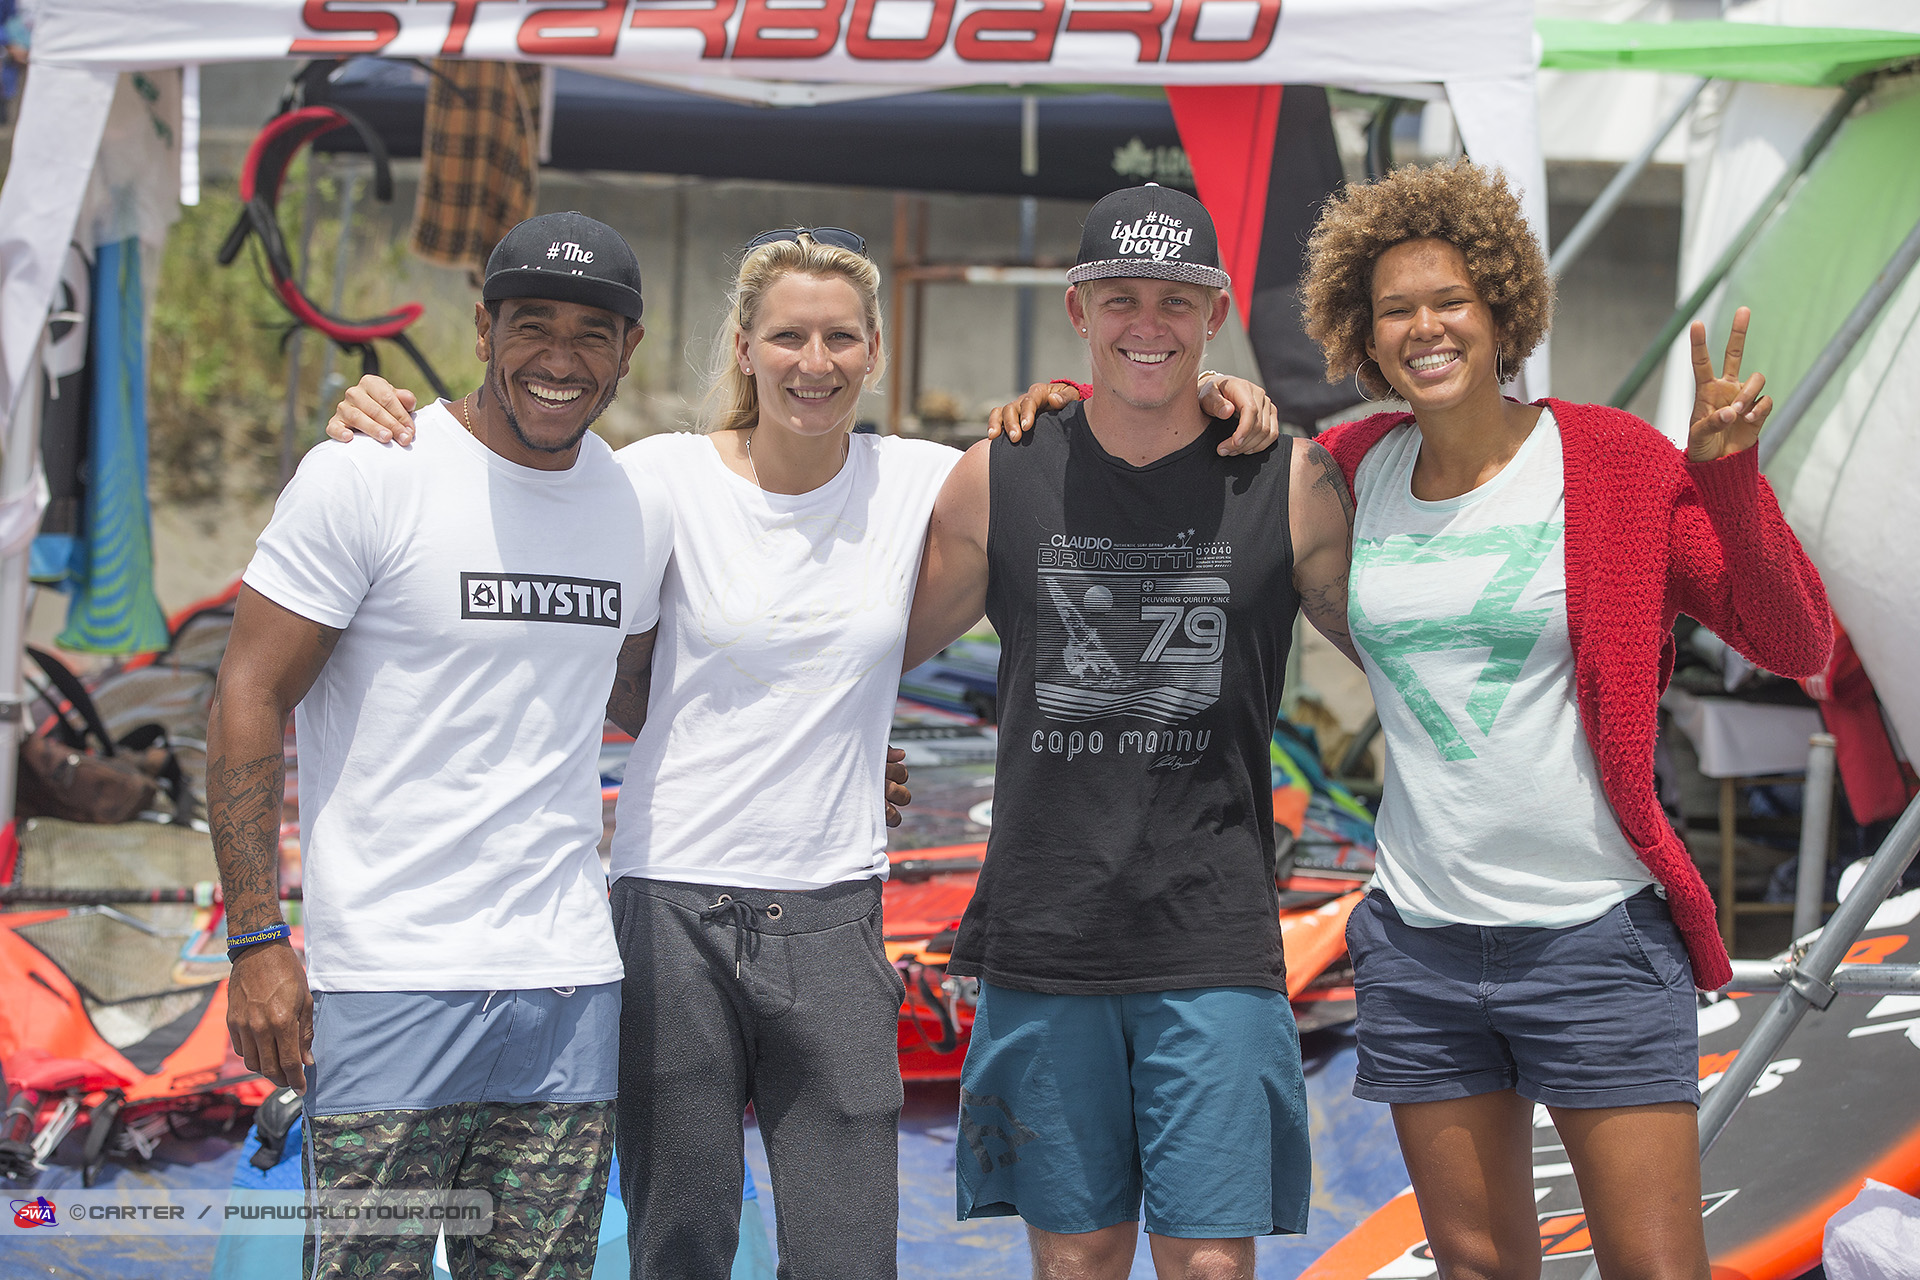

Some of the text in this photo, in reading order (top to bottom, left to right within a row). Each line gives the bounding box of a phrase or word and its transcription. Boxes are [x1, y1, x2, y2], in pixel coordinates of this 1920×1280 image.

[1145, 211, 1183, 228] #the
[1110, 219, 1193, 247] island
[546, 241, 594, 264] #The
[1118, 238, 1183, 261] boyz
[1050, 534, 1112, 550] CLAUDIO
[1196, 546, 1231, 555] 09040
[1037, 548, 1193, 569] BRUNOTTI
[501, 580, 617, 620] MYSTIC
[1141, 596, 1230, 604] DELIVERING QUALITY SINCE
[1140, 605, 1227, 662] 79
[1031, 729, 1211, 761] capo mannu
